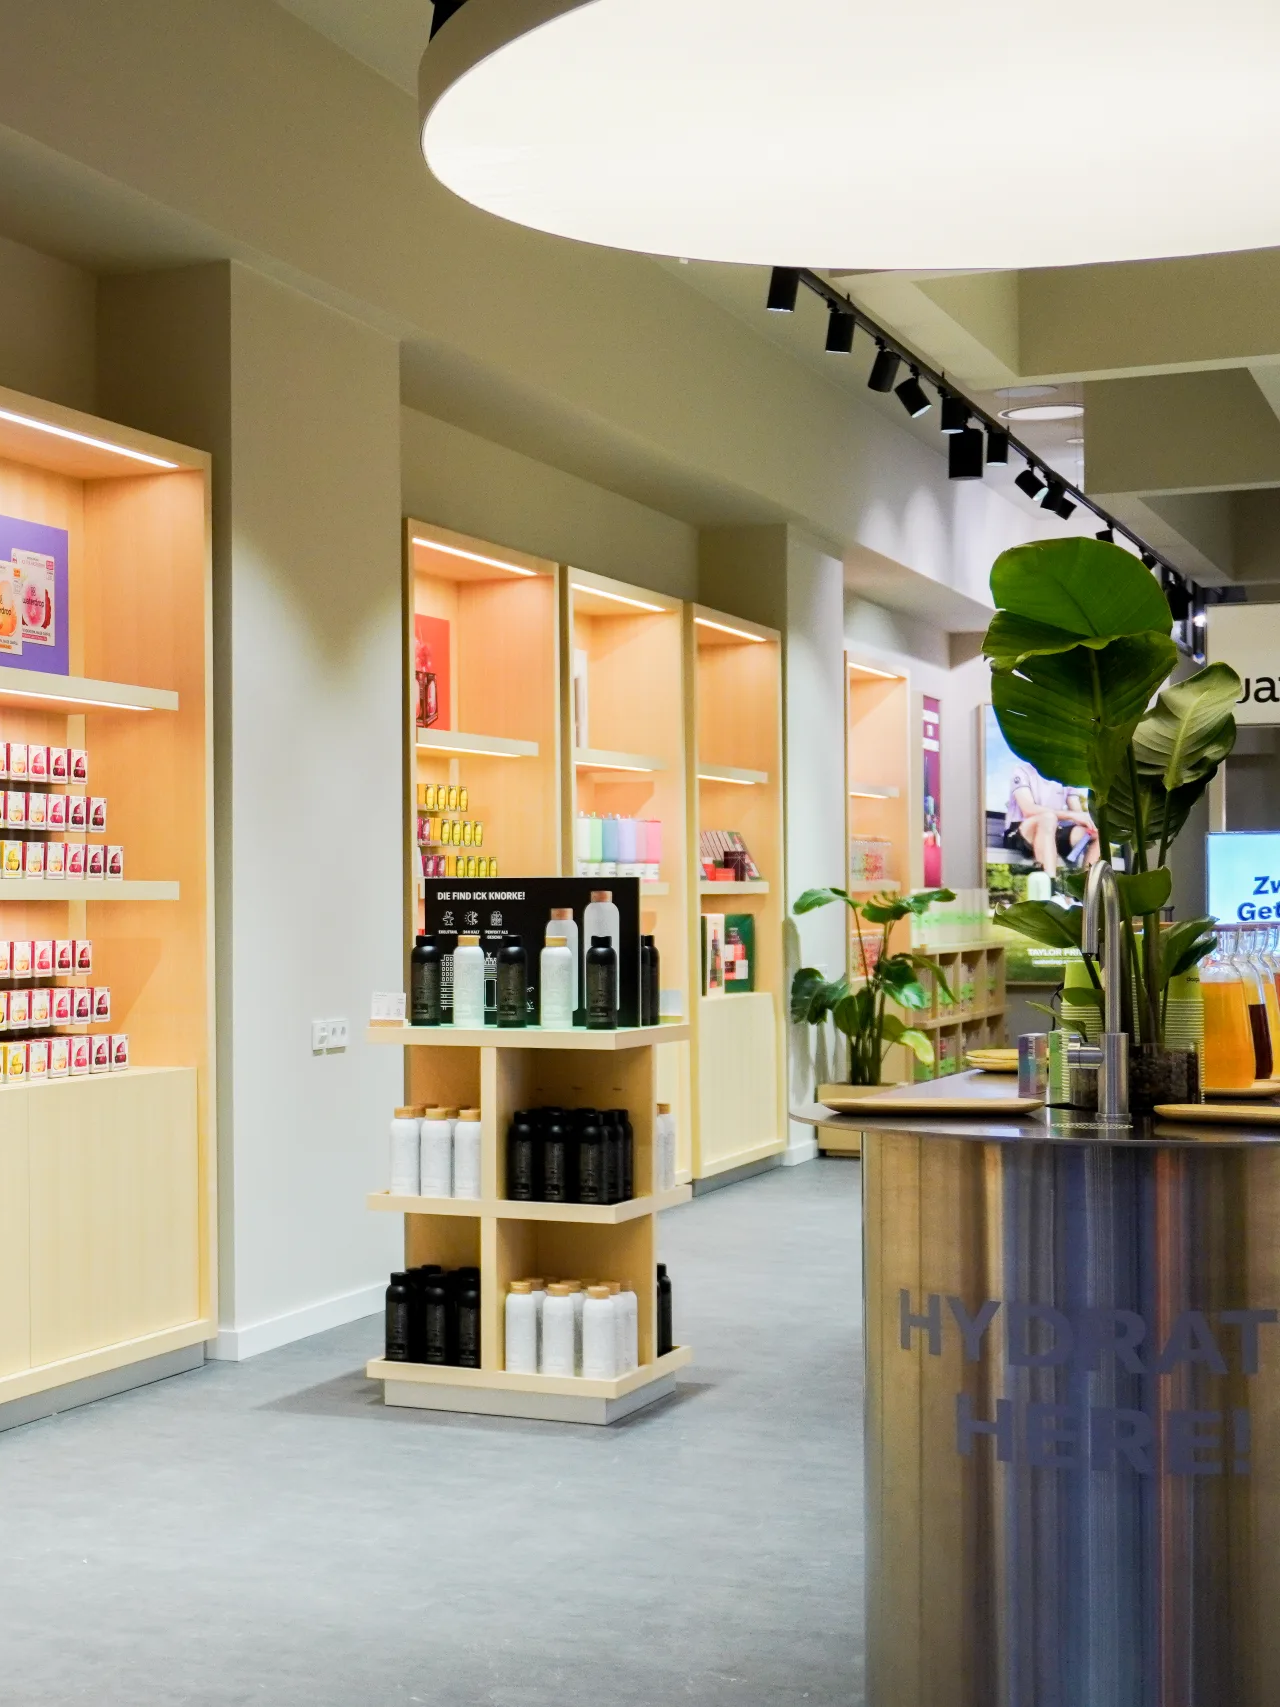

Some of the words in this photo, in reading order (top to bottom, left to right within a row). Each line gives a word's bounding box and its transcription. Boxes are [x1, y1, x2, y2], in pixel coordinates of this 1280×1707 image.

[437, 892, 451, 900] DIE
[452, 892, 472, 900] FIND
[473, 892, 487, 900] ICK
[488, 891, 526, 900] KNORKE!
[1027, 948, 1063, 956] TAYLOR
[899, 1288, 1279, 1375] HYDRAT
[956, 1391, 1253, 1476] HERE!
